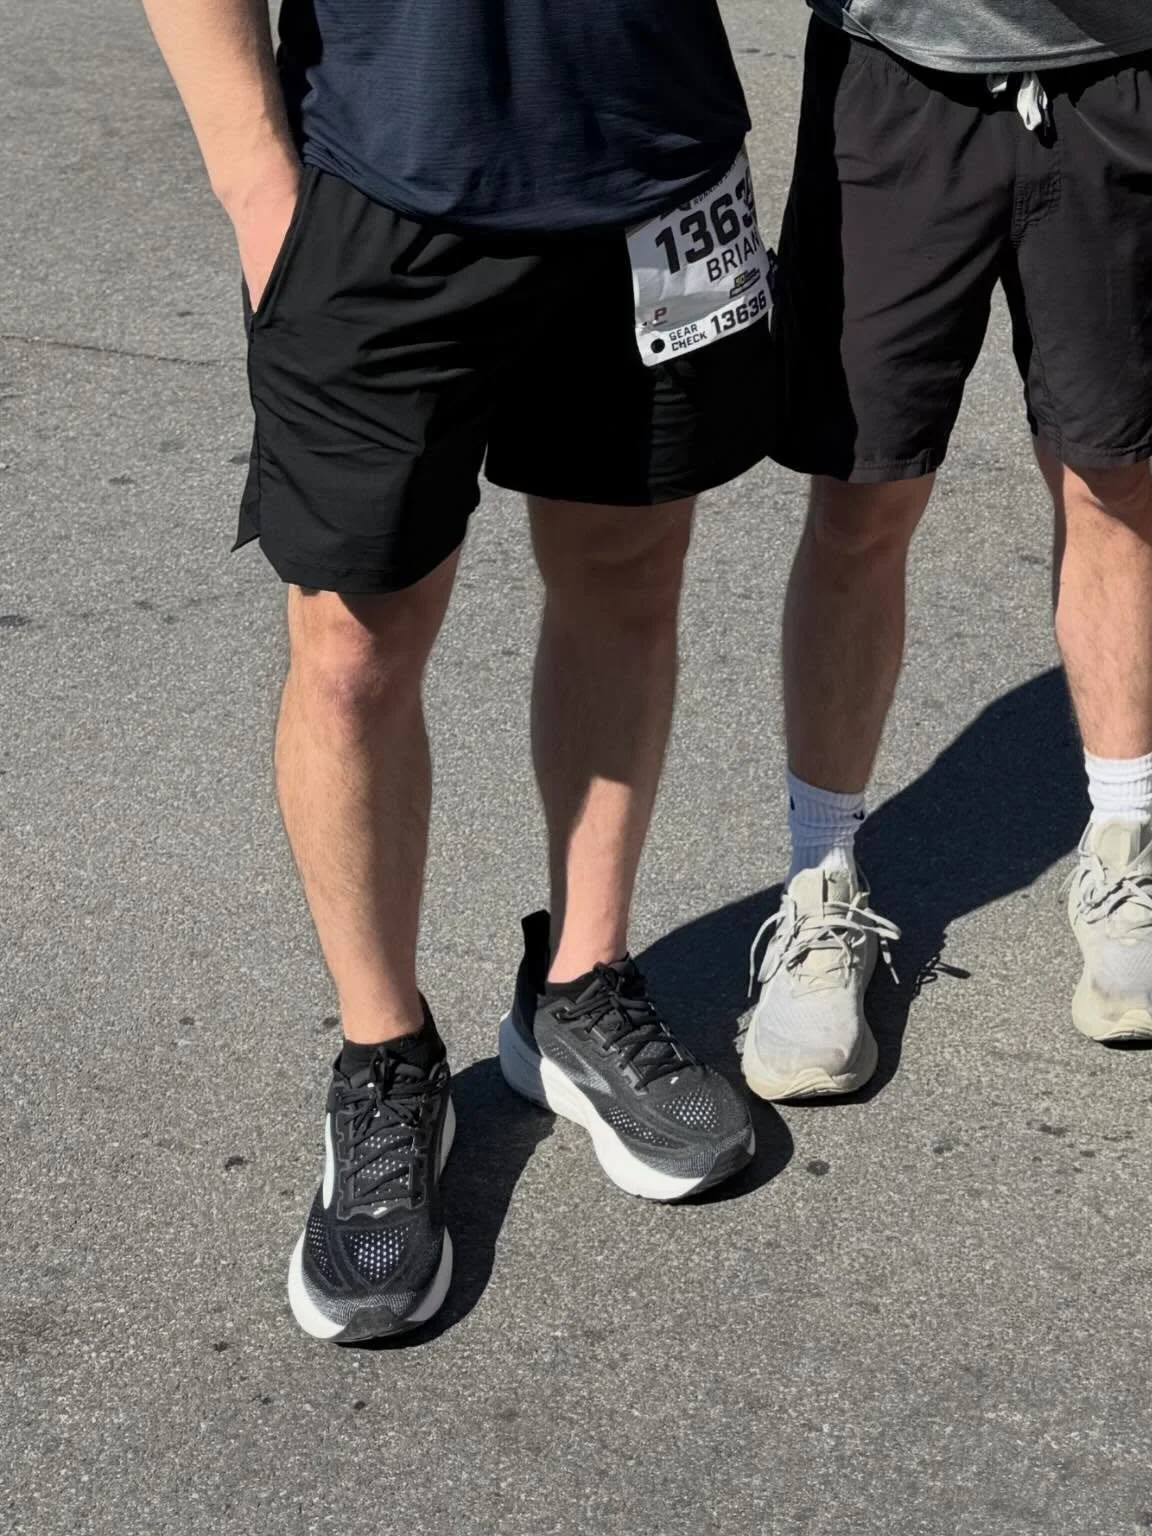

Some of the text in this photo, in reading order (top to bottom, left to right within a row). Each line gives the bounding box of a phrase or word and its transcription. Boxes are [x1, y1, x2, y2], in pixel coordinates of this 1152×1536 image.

[655, 166, 755, 274] 1363
[653, 307, 667, 322] P
[710, 290, 767, 335] 13636
[668, 323, 699, 341] GEAR
[671, 331, 708, 352] CHECK
